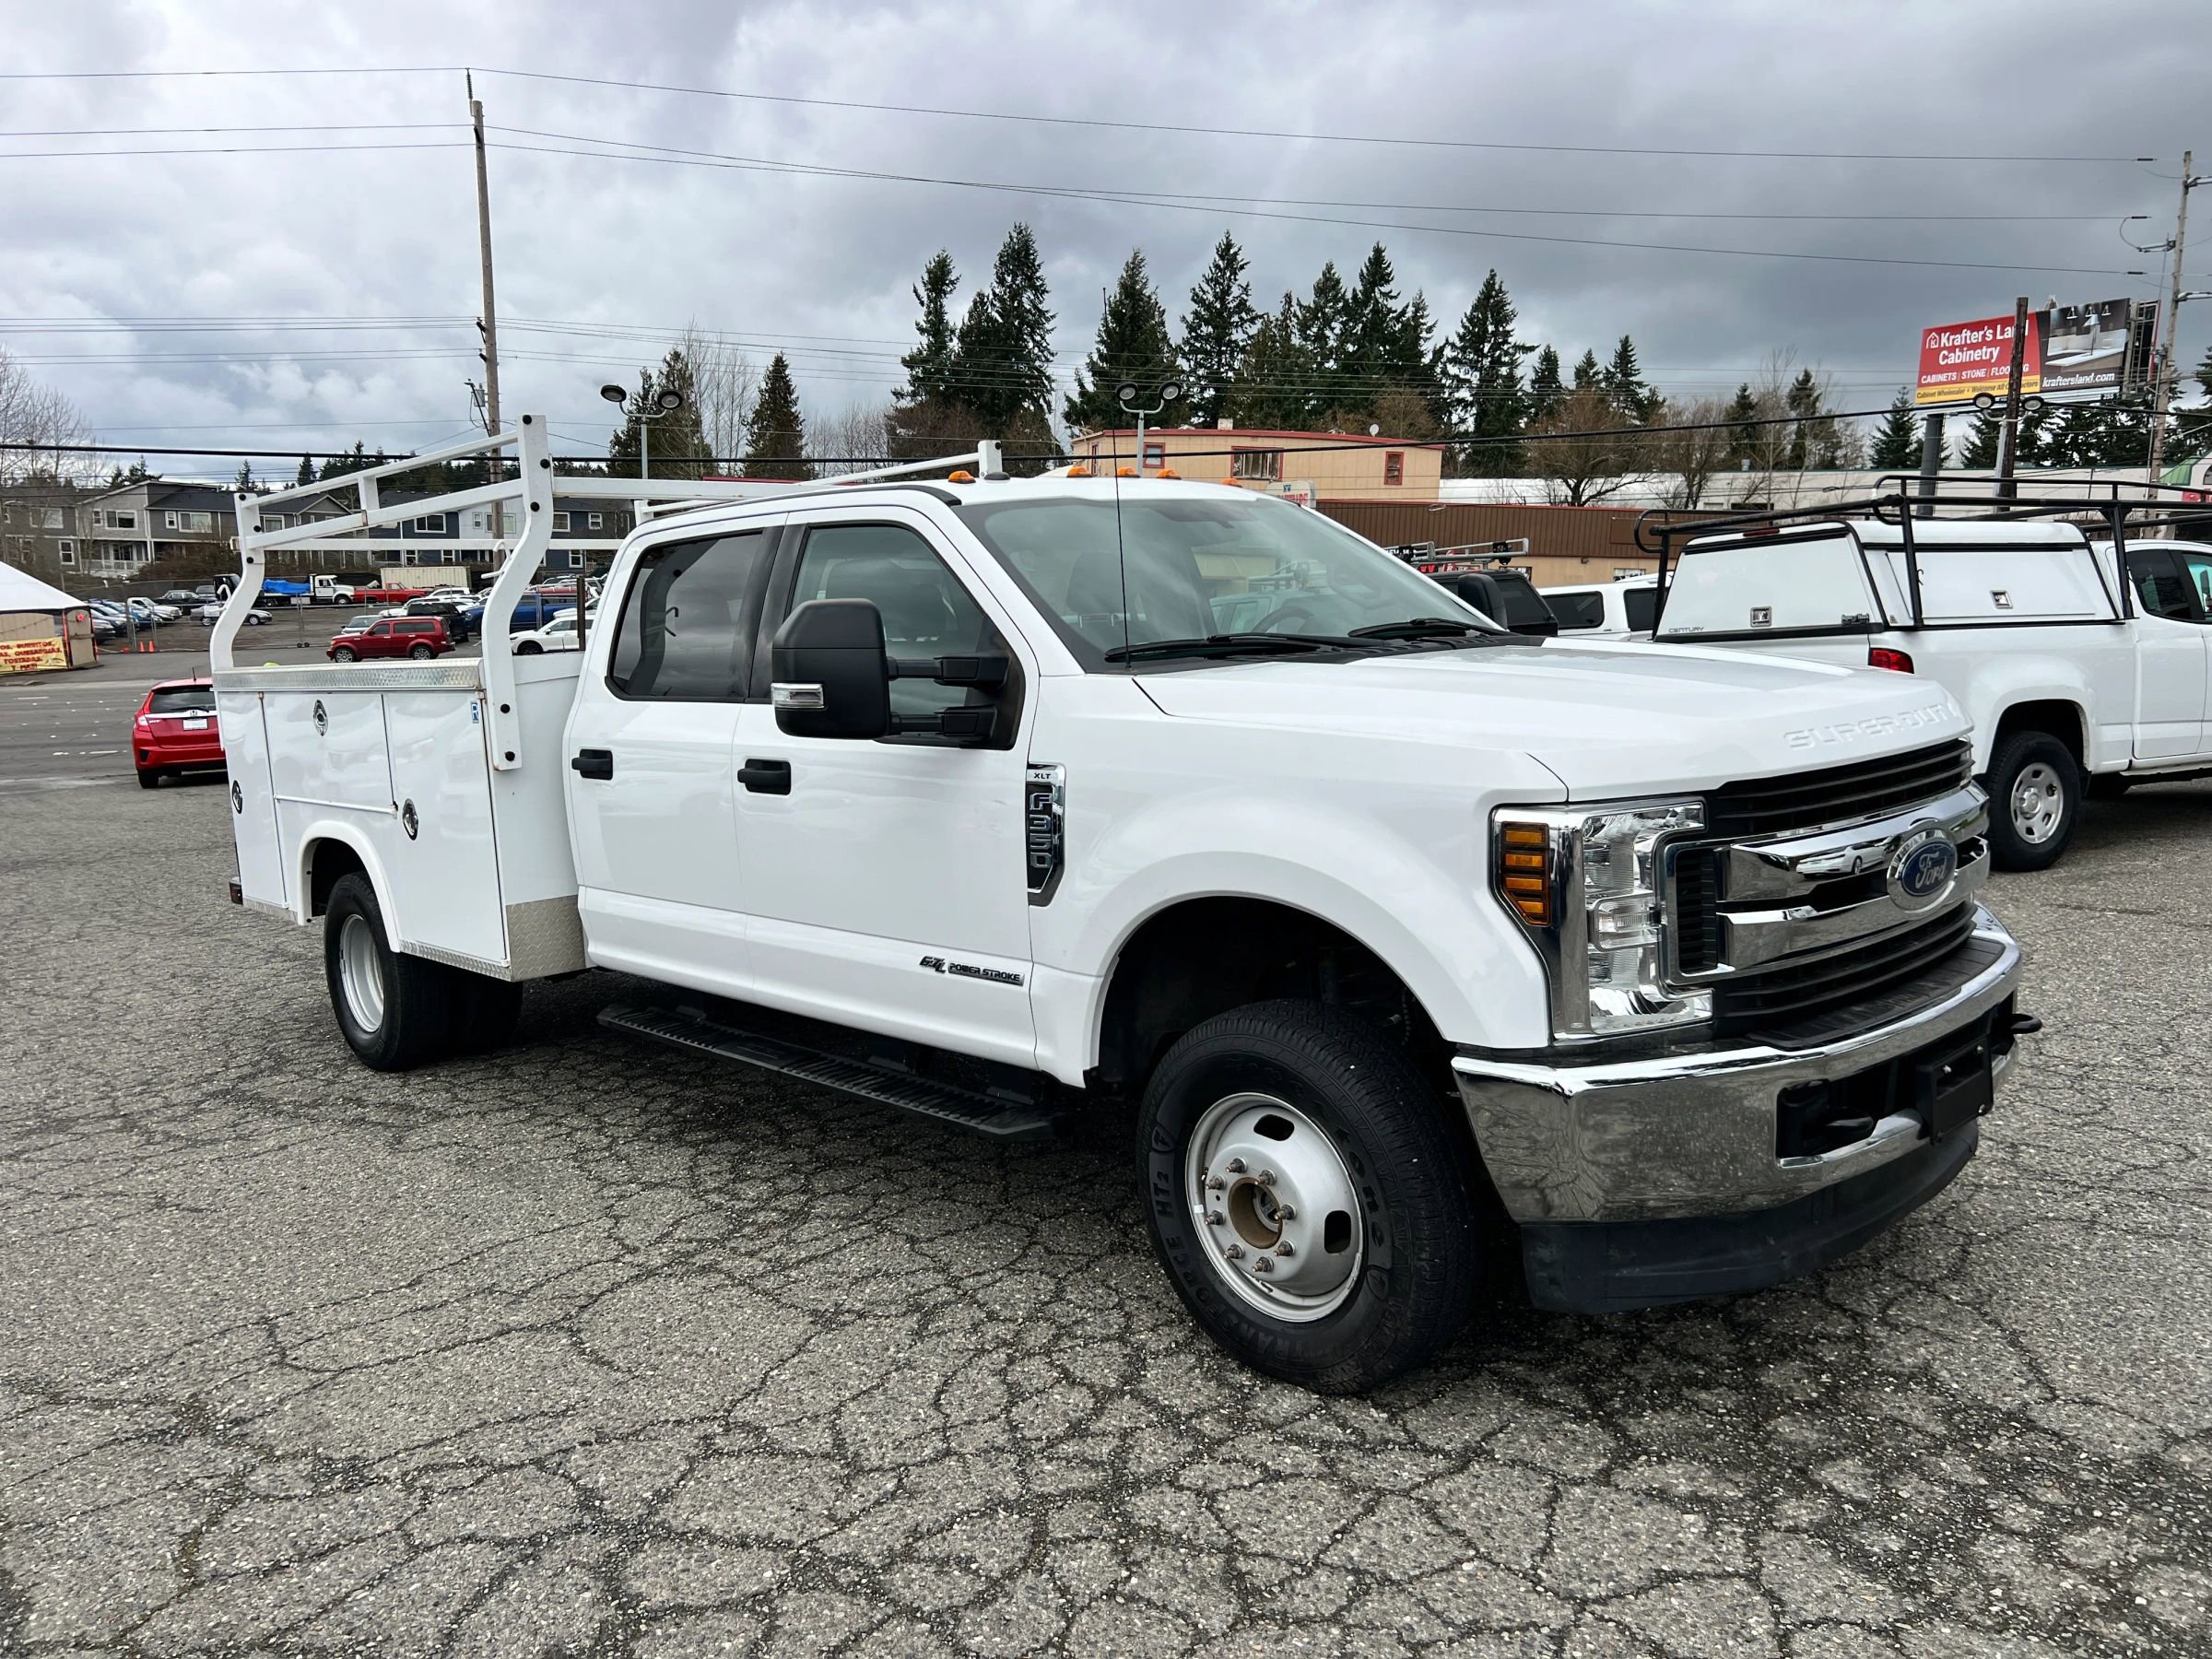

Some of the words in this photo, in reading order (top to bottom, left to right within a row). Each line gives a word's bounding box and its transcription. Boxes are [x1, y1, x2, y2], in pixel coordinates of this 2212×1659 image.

[1940, 325, 1994, 347] Krafter's
[1938, 346, 2000, 366] Cabinetry
[1921, 371, 1958, 384] CABINETS
[1960, 368, 1987, 380] STONE
[1991, 363, 2030, 377] FLOOG
[2041, 371, 2115, 388] kraftersland.com
[1668, 626, 1704, 634] CENTURY
[1784, 715, 1902, 751] SUPER
[1896, 702, 1959, 730] DUTY
[1029, 792, 1053, 869] F350
[1915, 853, 1947, 890] Ford
[949, 962, 982, 975] POWER
[982, 968, 1021, 982] STROKE
